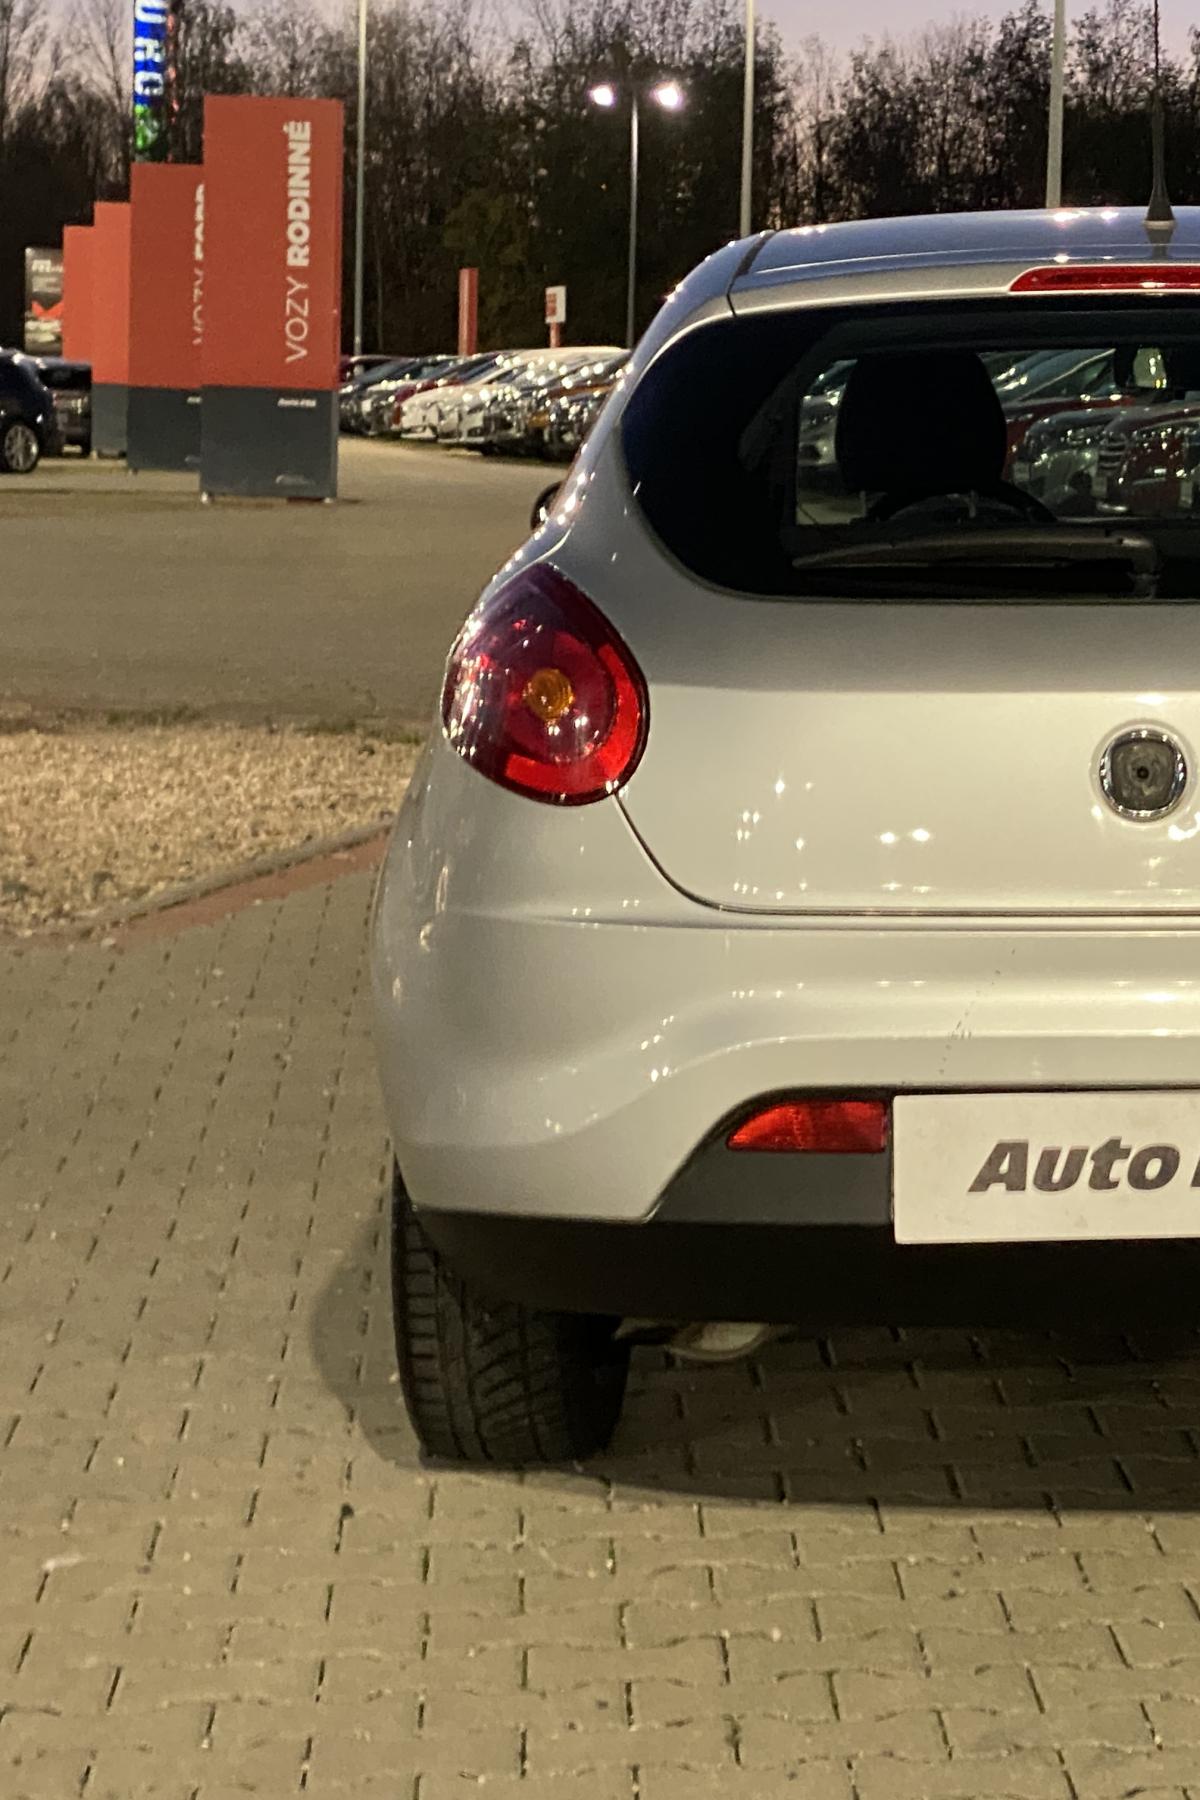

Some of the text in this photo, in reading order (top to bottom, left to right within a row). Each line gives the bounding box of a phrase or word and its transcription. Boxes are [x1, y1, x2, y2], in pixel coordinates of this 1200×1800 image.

[283, 120, 311, 362] VOZY RODINNÉ
[967, 1136, 1181, 1193] Auto
